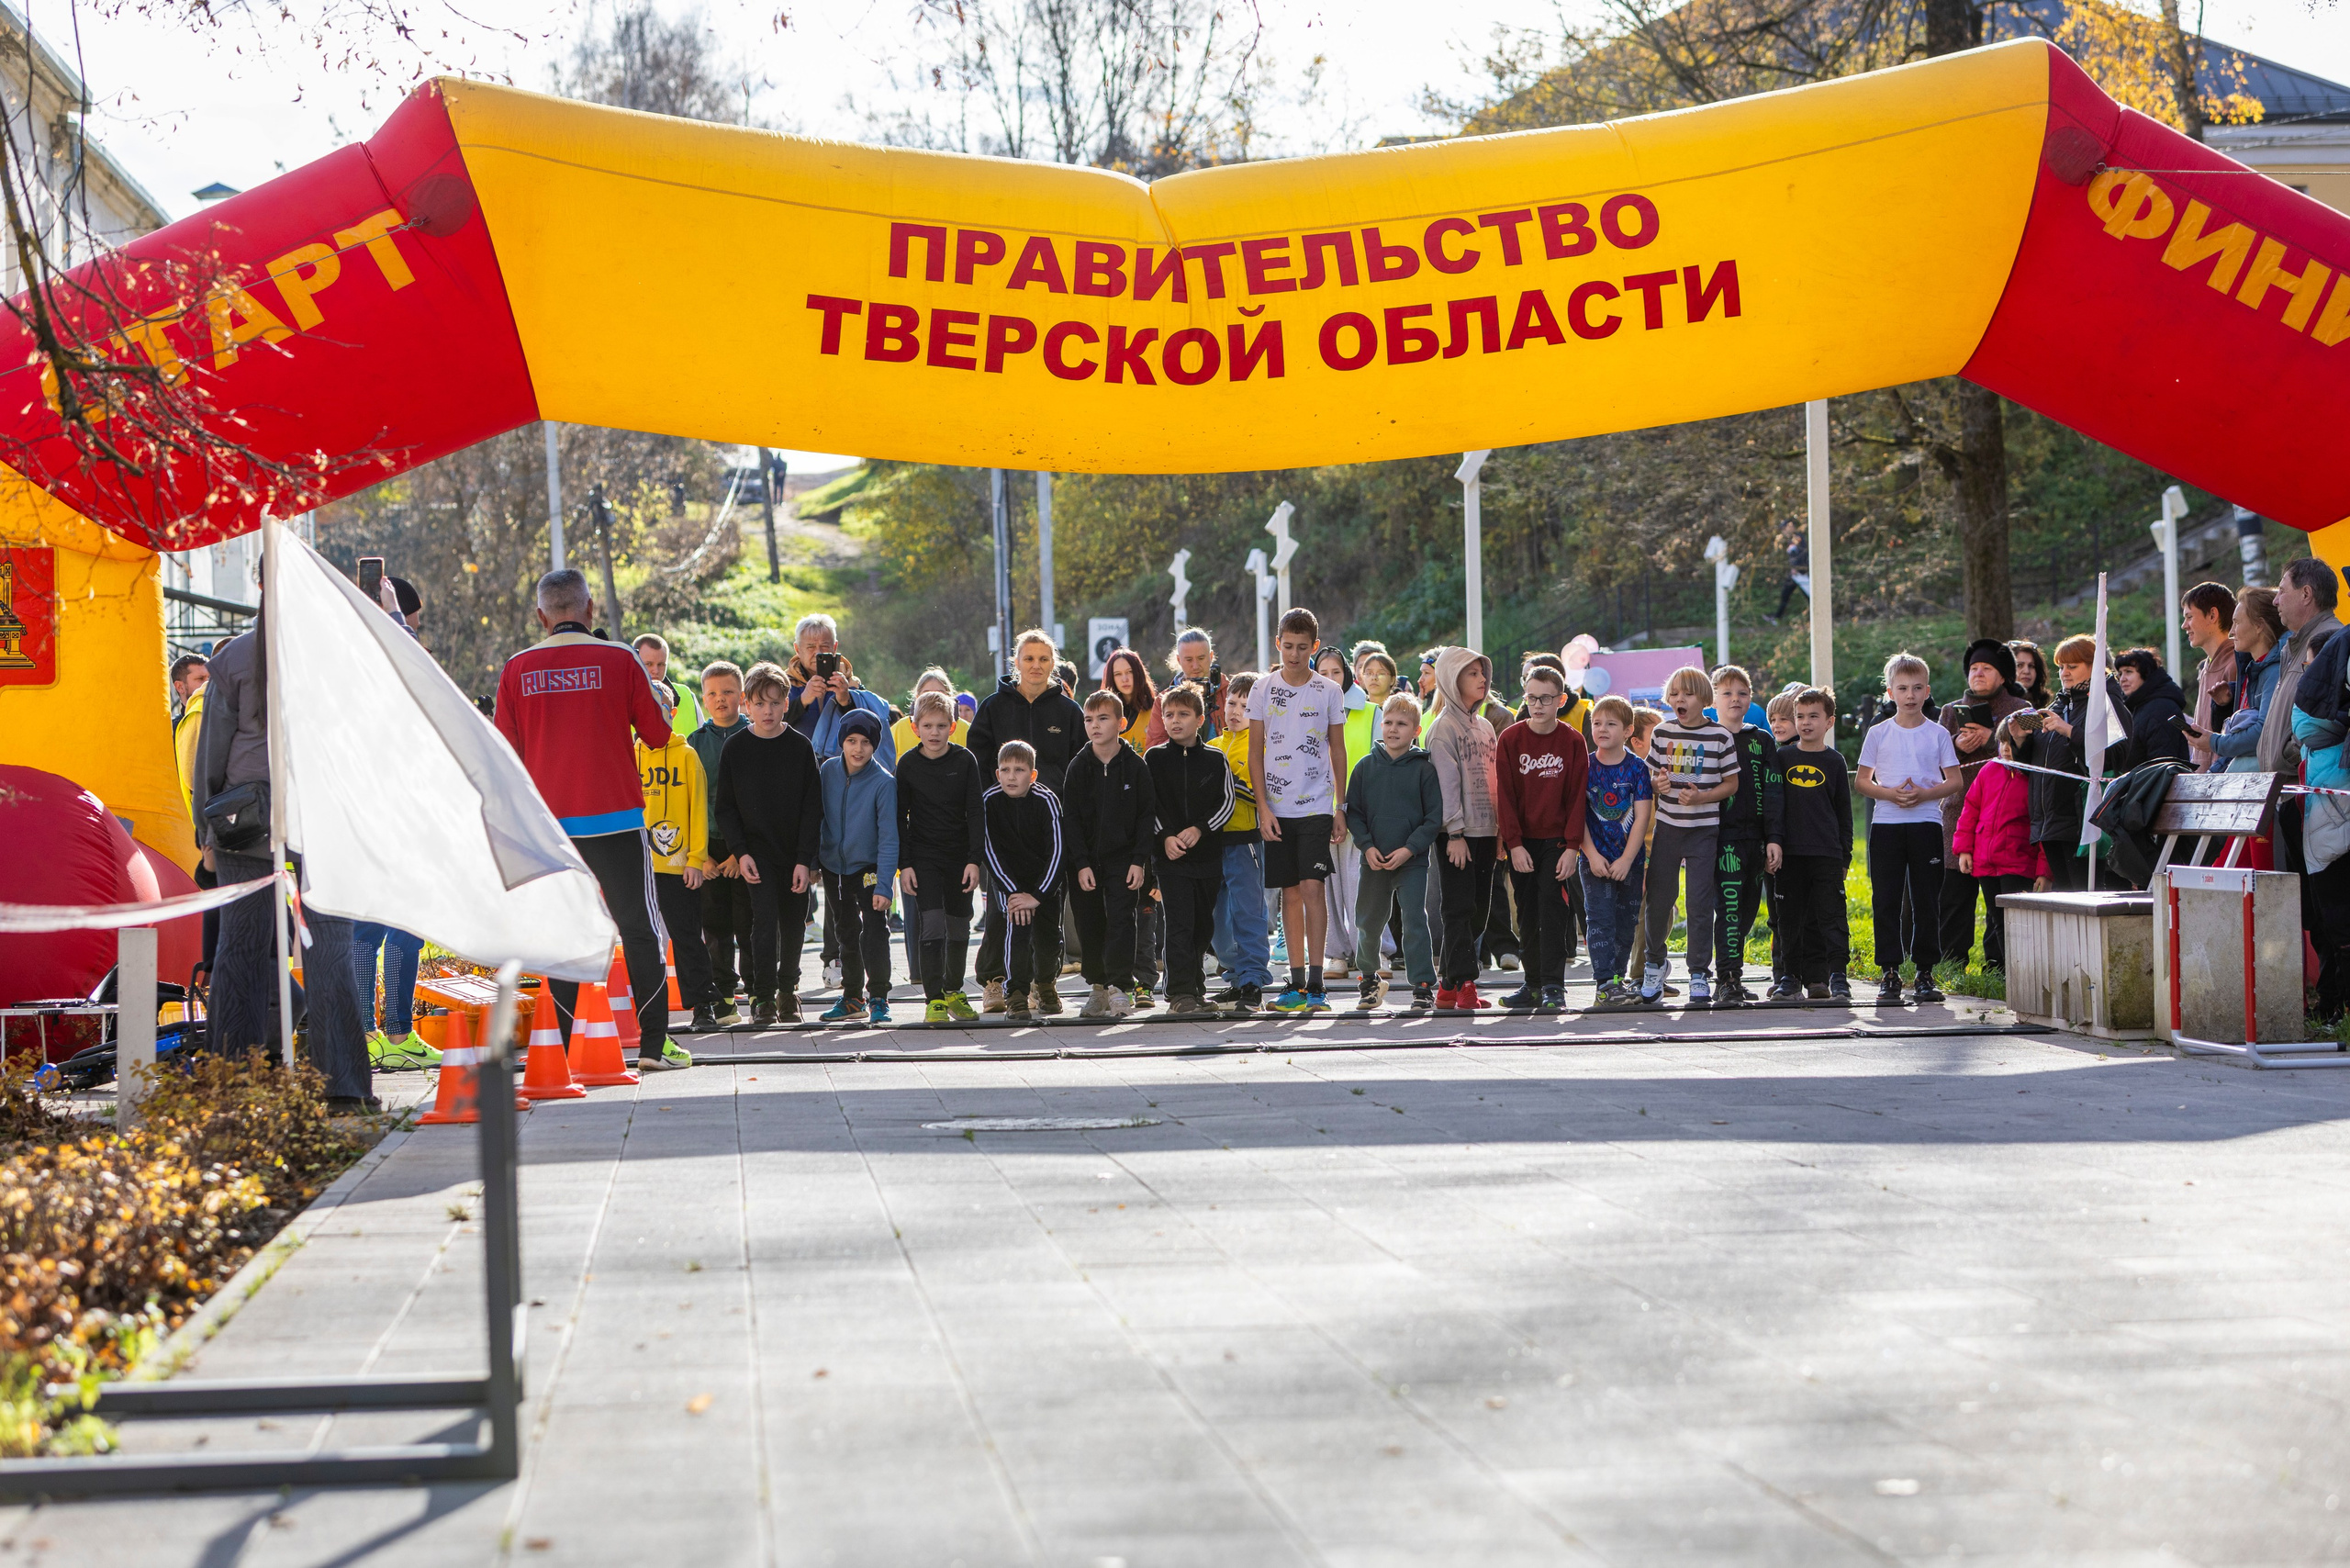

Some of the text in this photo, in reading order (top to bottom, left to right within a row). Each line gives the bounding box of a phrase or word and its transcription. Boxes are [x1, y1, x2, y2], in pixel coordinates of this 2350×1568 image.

[889, 194, 1660, 304] ПРАВИТЕЛЬСТВО
[40, 208, 416, 425] СТАРТ
[806, 259, 1741, 386] ТВЕРСКОЙ ОБЛАСТИ
[520, 666, 602, 697] RUSSIA
[1270, 687, 1297, 698] ENJOY
[1271, 697, 1287, 707] THE
[1519, 753, 1563, 775] Boston
[1666, 755, 1705, 766] SURF
[1266, 772, 1292, 787] ENJOY
[1267, 783, 1282, 795] THE
[1718, 852, 1741, 873] KING
